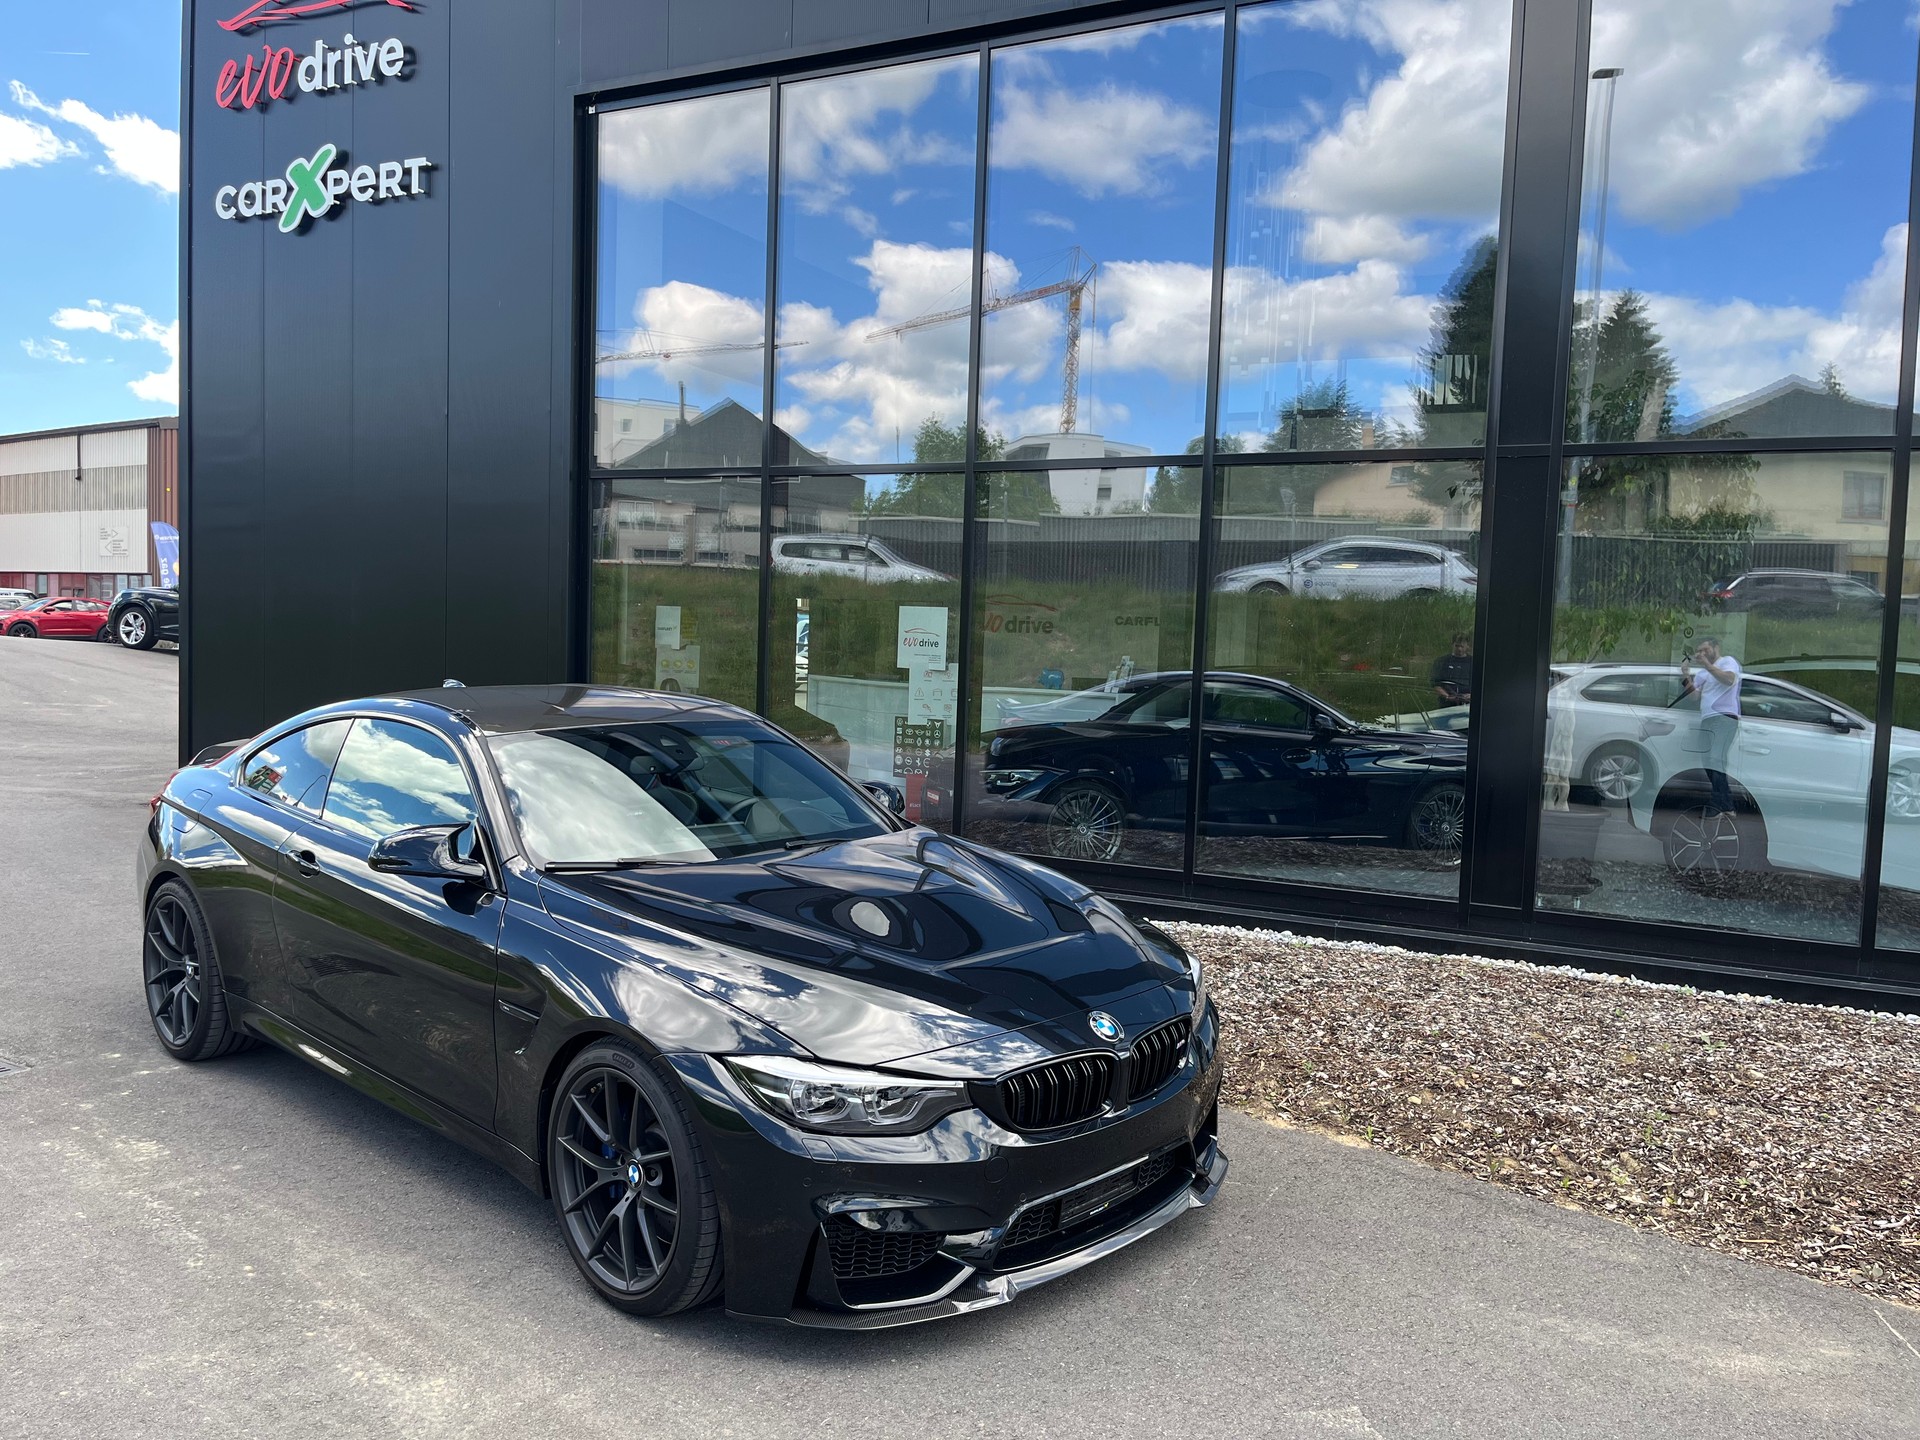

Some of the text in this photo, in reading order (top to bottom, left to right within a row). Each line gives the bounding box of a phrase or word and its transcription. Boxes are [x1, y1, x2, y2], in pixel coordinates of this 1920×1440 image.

[297, 33, 404, 92] drive
[1004, 615, 1054, 634] drive
[919, 638, 939, 648] drive
